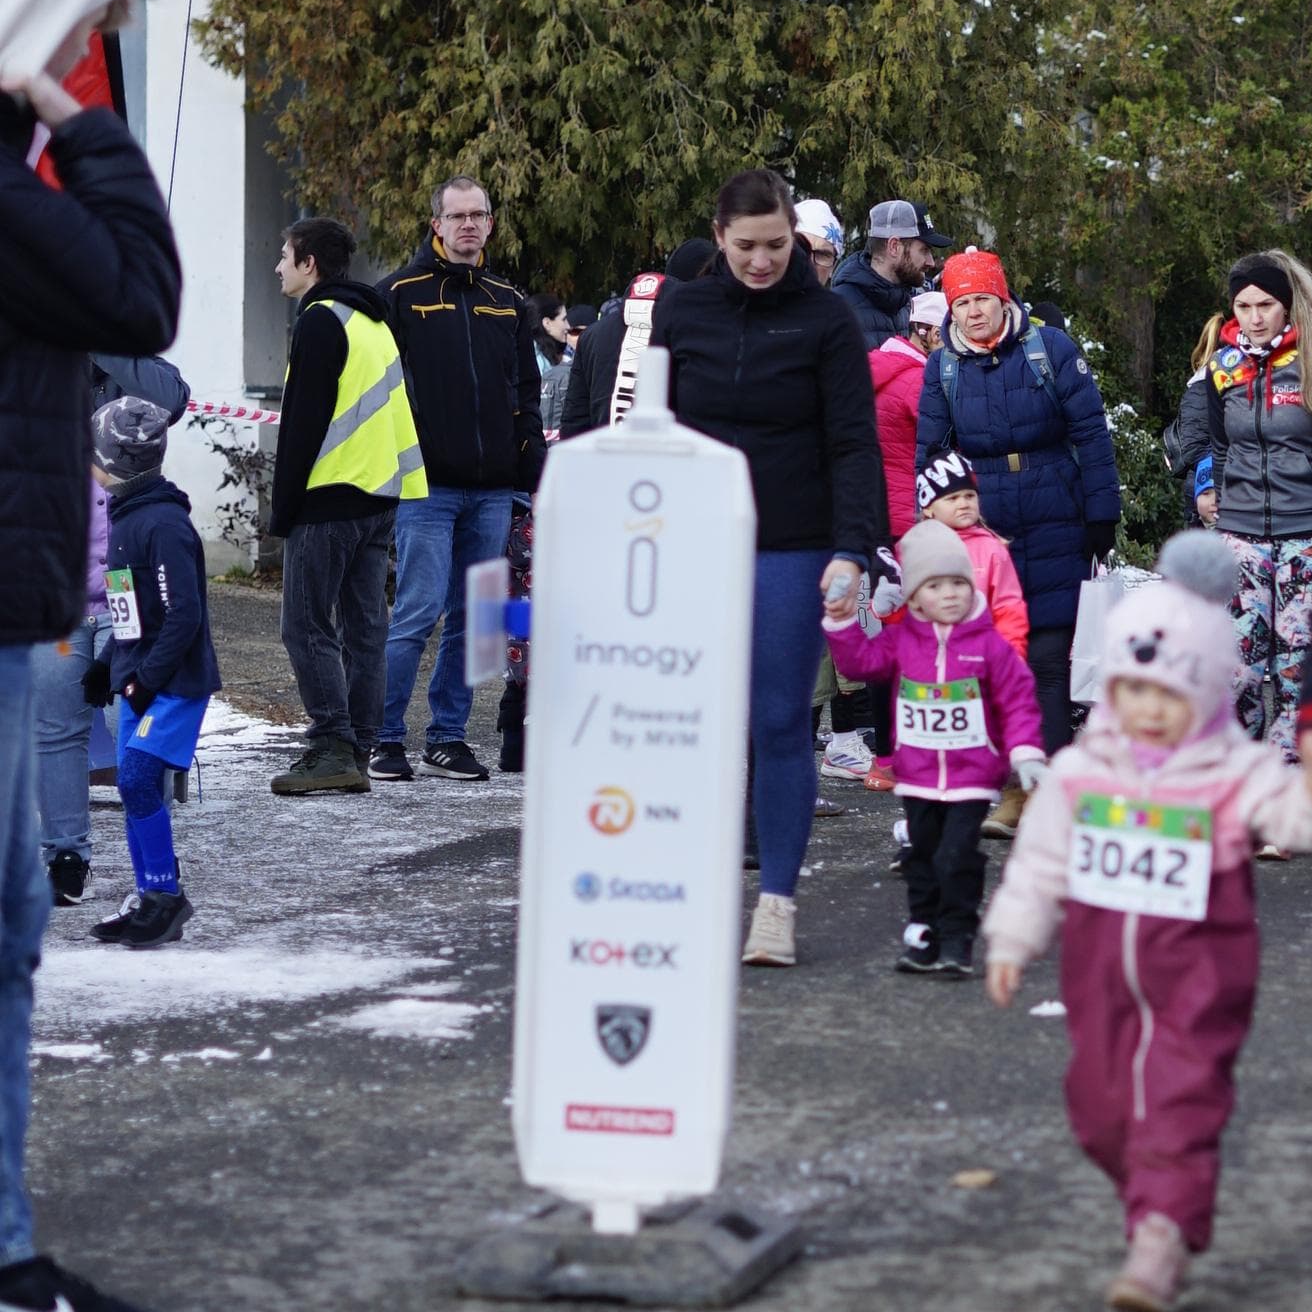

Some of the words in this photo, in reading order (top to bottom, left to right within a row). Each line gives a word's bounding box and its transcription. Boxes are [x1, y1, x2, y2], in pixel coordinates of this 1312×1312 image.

[575, 634, 702, 675] innogy
[903, 704, 968, 732] 3128
[646, 804, 681, 822] NN
[1078, 834, 1189, 887] 3042
